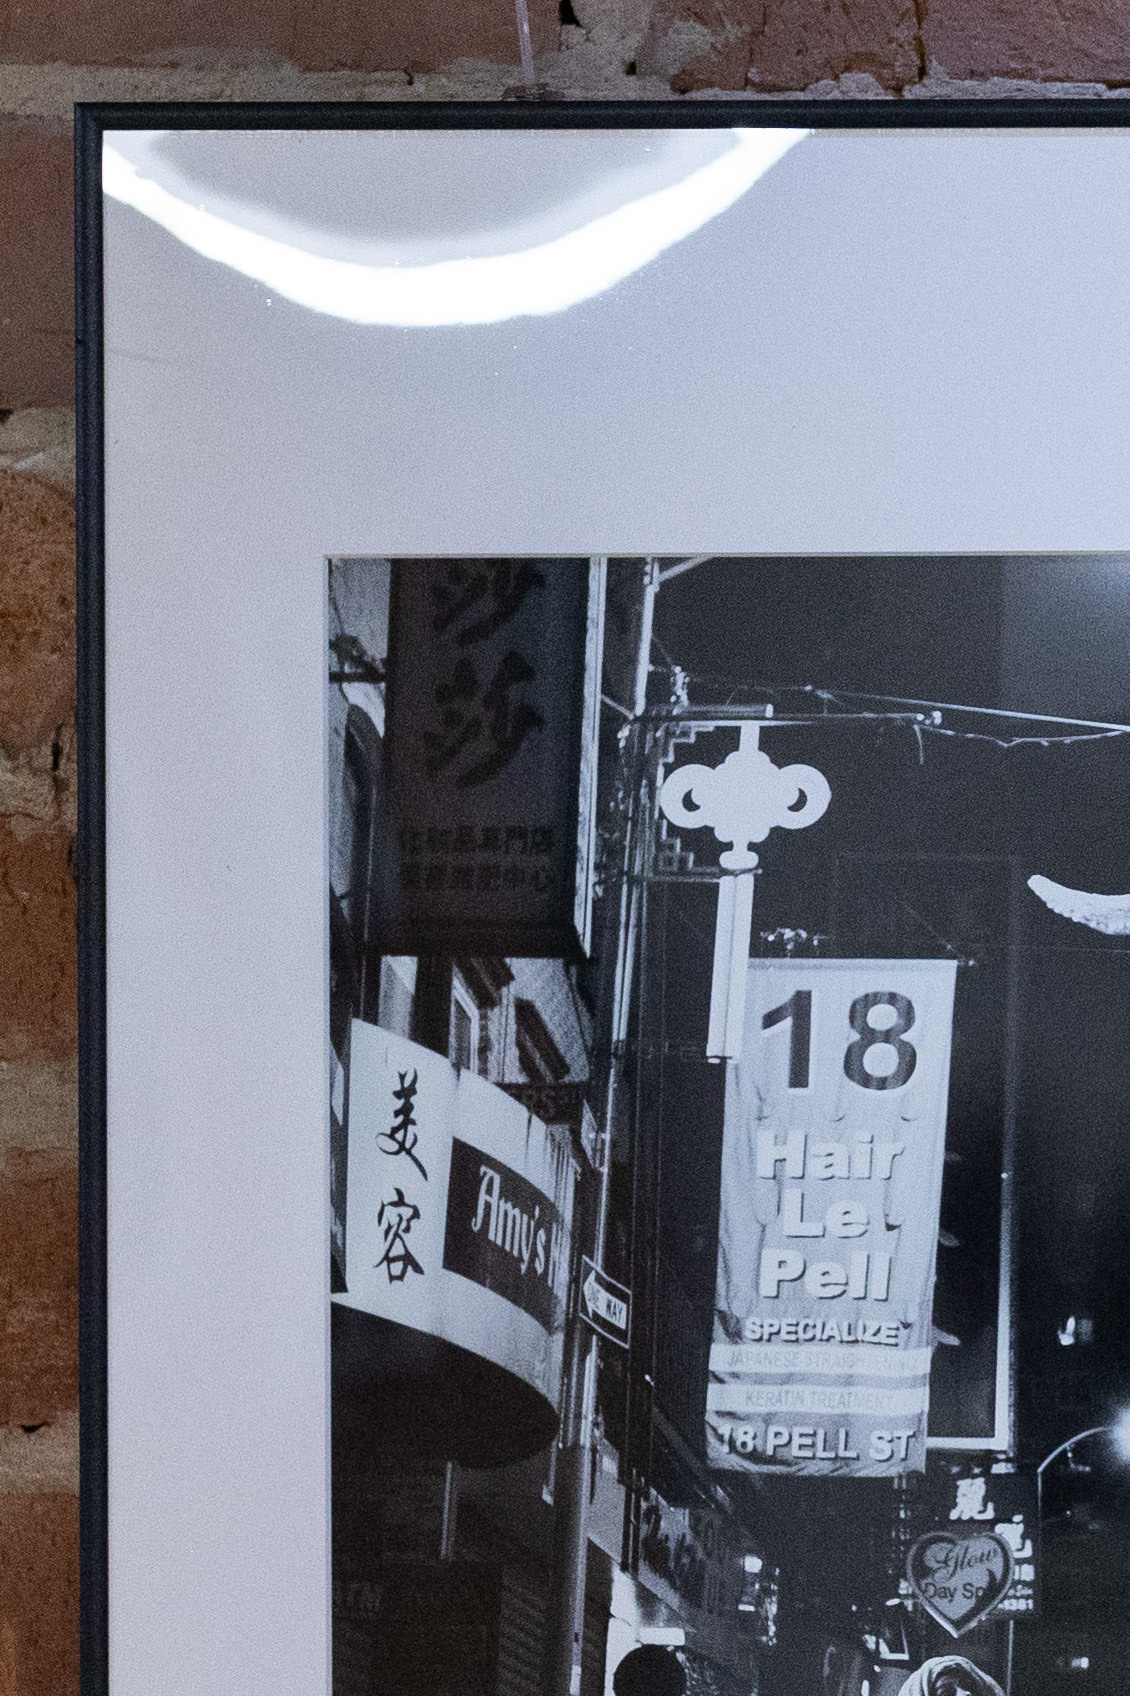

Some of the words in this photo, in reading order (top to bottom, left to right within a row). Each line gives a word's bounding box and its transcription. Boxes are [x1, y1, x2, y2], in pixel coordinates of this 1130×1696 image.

[760, 989, 917, 1091] 18
[756, 1129, 905, 1180] Hair
[471, 1164, 547, 1276] Amy's
[782, 1188, 870, 1239] Le
[759, 1248, 893, 1302] Pell
[605, 1297, 624, 1324] WAY
[743, 1316, 901, 1347] SPECIALIZE
[728, 1352, 800, 1369] JAPANESE
[745, 1389, 805, 1406] KERATIN
[810, 1391, 895, 1409] TREATMENT
[716, 1424, 758, 1455] 18
[766, 1426, 859, 1461] PELL
[869, 1430, 918, 1464] ST
[924, 1582, 957, 1603] Day
[962, 1582, 987, 1602] Sp
